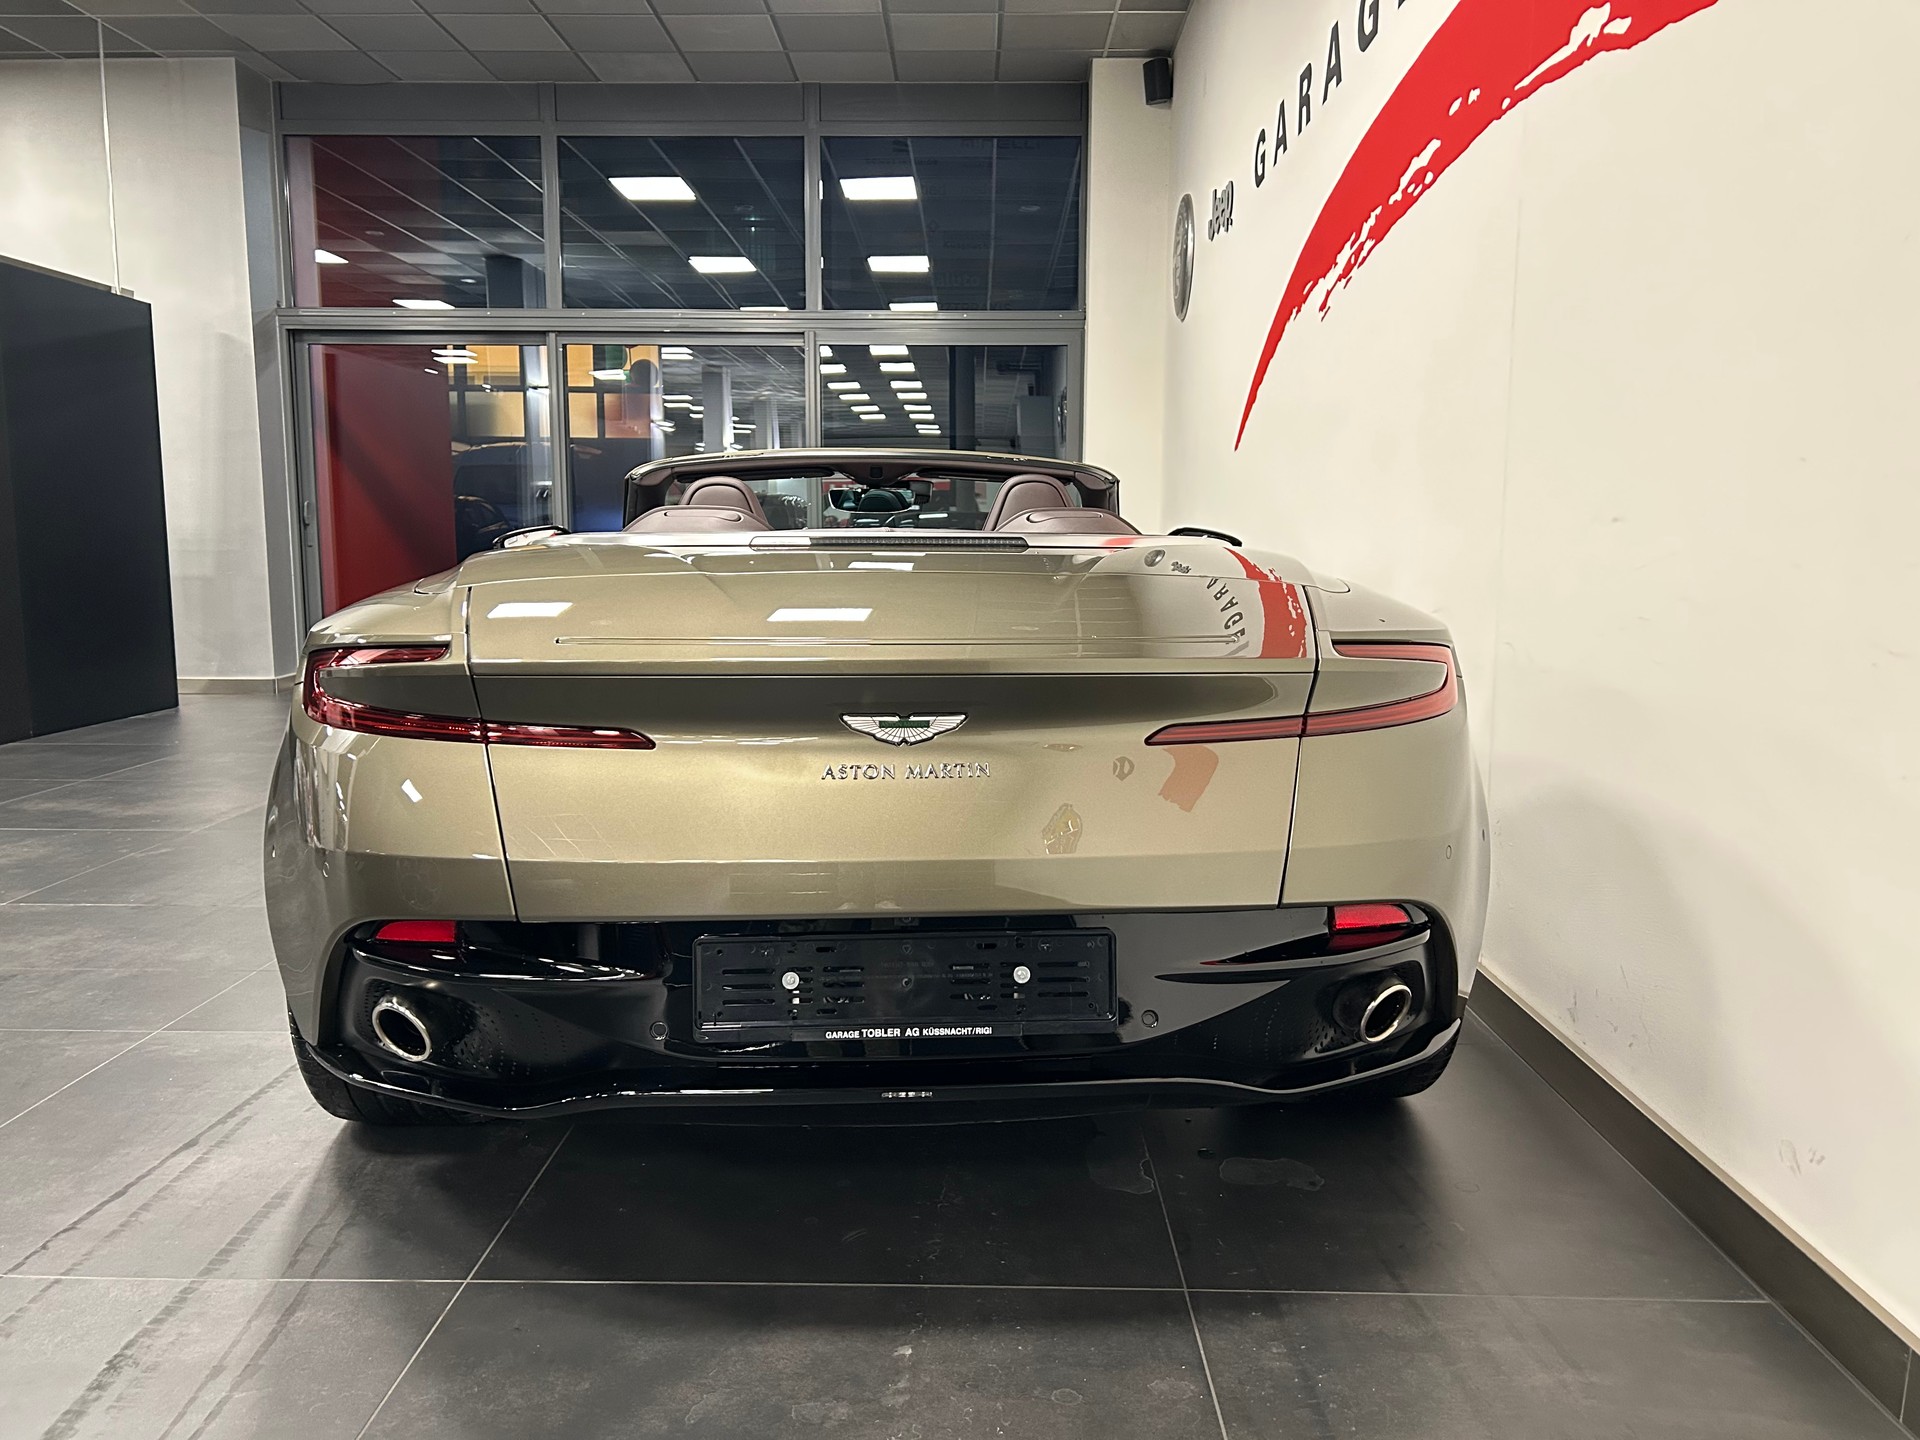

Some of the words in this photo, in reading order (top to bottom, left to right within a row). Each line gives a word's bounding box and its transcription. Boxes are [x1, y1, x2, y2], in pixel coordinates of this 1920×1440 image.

[1254, 0, 1406, 188] GARAG
[1208, 180, 1234, 242] Jeep
[821, 763, 895, 780] ASTON
[905, 762, 991, 780] MARTIN
[825, 1030, 860, 1039] GARAGE
[861, 1028, 901, 1038] TOBLER
[904, 1027, 920, 1037] AG
[922, 1026, 993, 1036] KÜSSNACHT/RIGI
